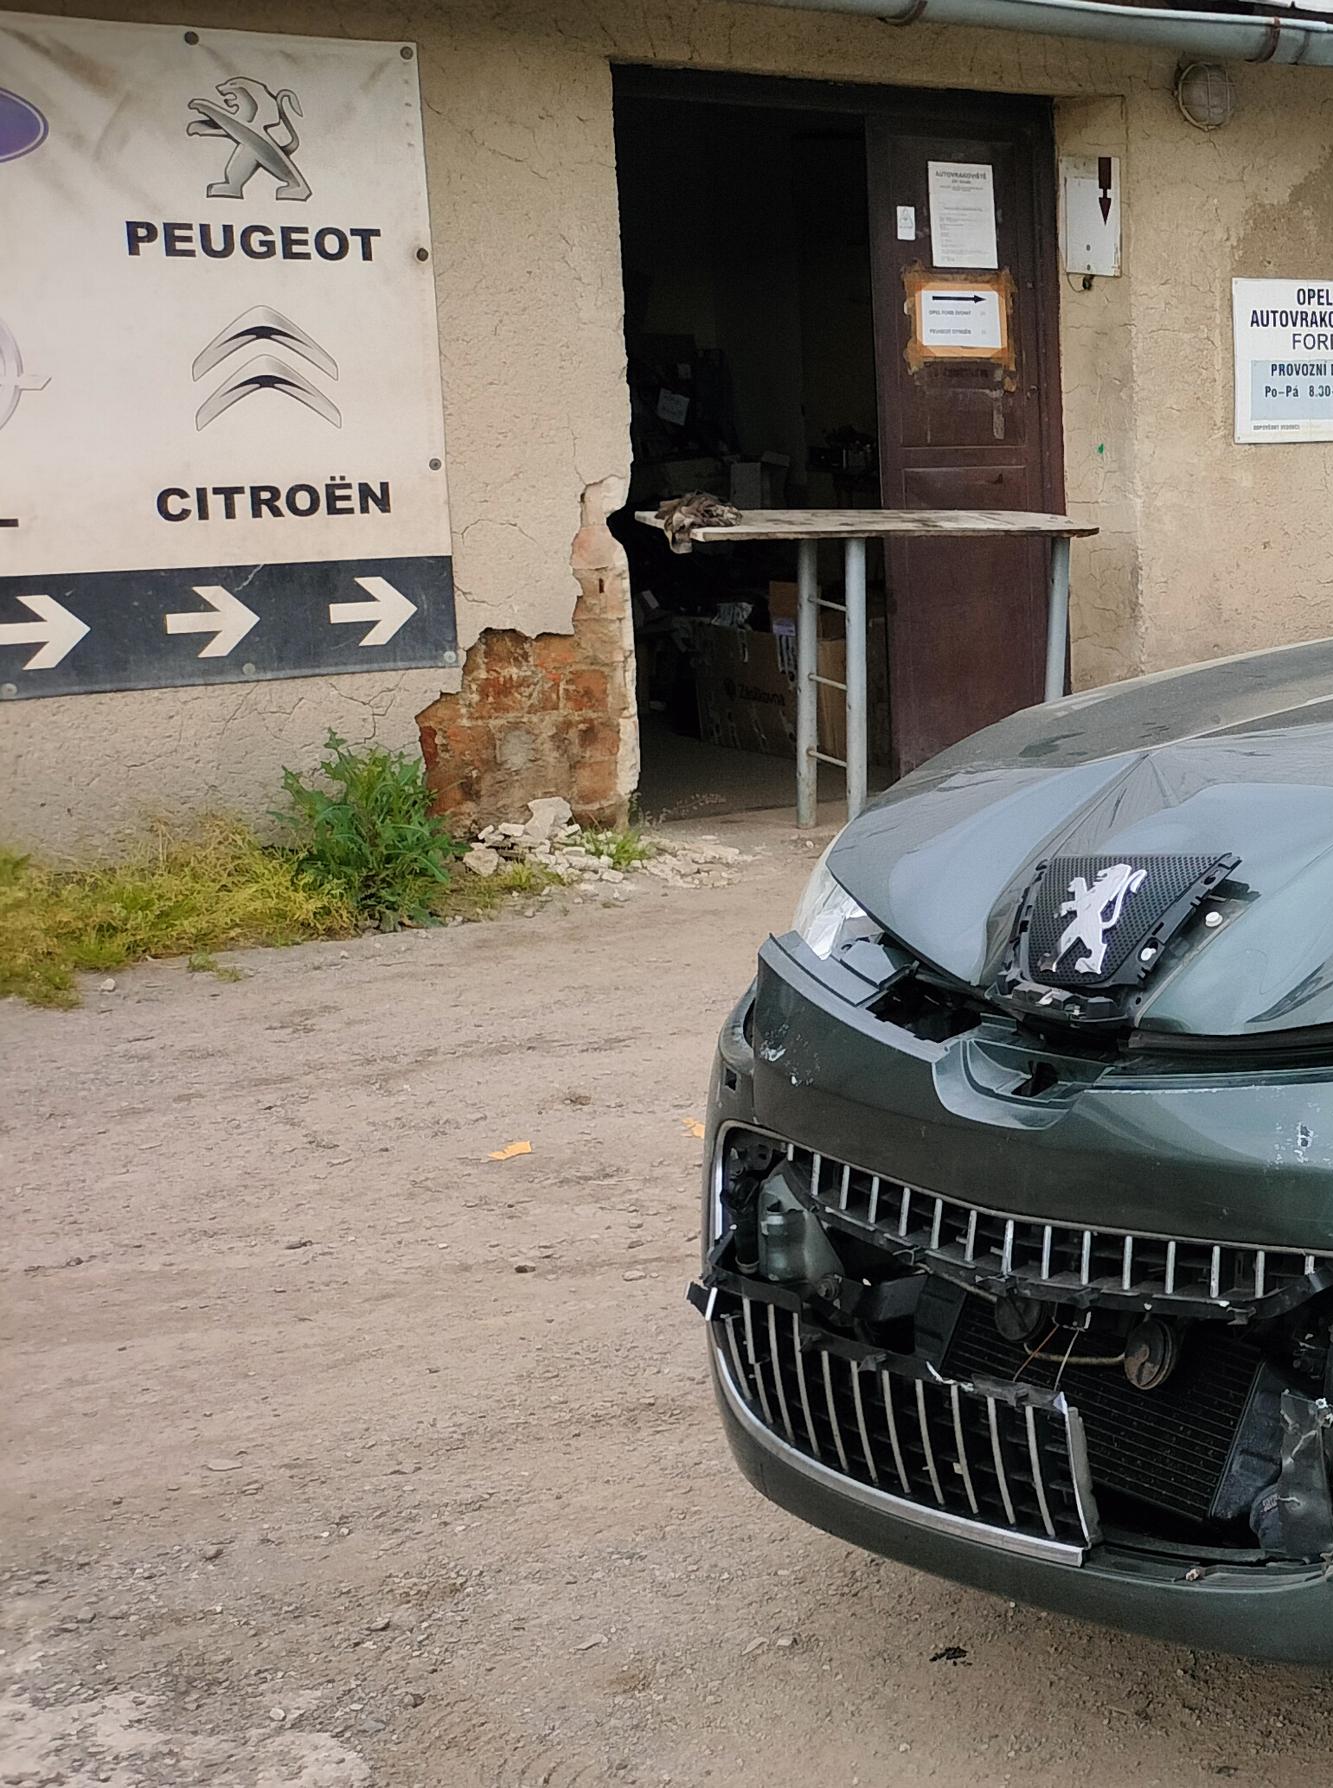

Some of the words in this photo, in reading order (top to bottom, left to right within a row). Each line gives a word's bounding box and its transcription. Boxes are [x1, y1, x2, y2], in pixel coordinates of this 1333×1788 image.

[125, 220, 381, 262] PEUGEOT
[1296, 288, 1333, 306] OPEL
[1270, 361, 1327, 377] PROVOZNÍ
[156, 475, 392, 522] CITROËN
